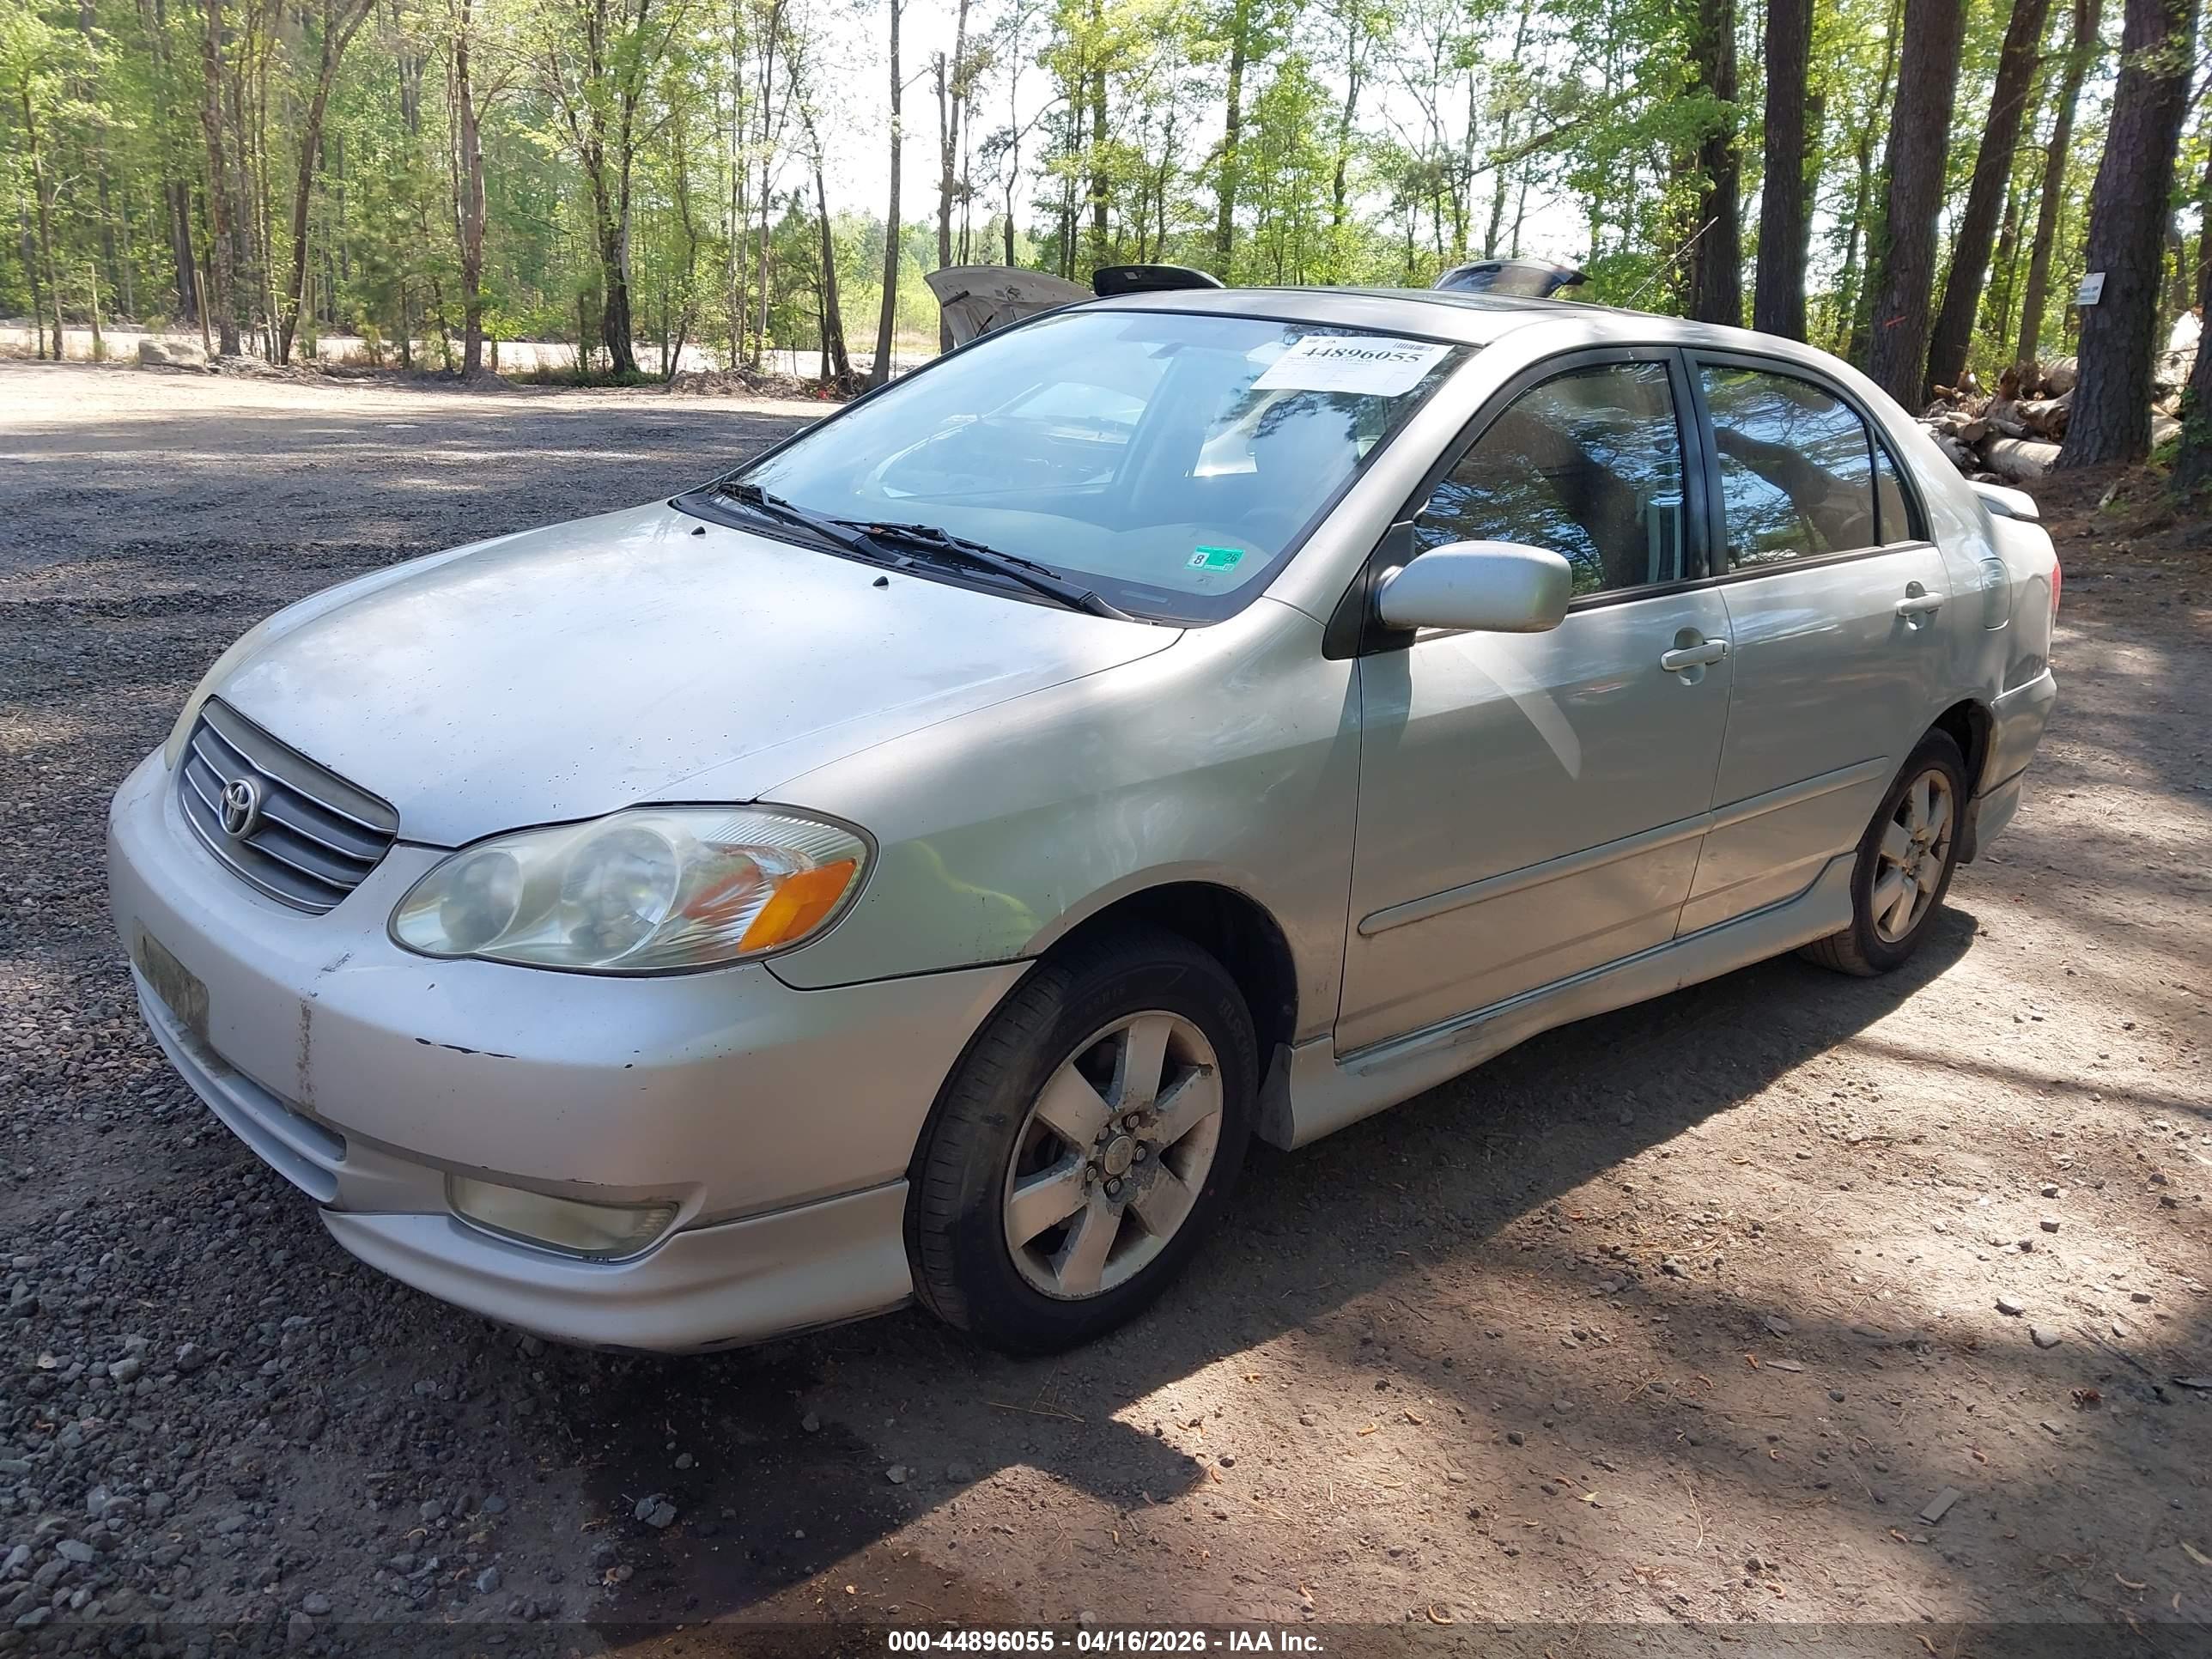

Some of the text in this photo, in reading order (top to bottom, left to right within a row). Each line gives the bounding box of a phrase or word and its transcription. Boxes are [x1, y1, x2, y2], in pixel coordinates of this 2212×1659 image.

[1301, 347, 1425, 364] 44896055
[1194, 553, 1239, 565] 8 26
